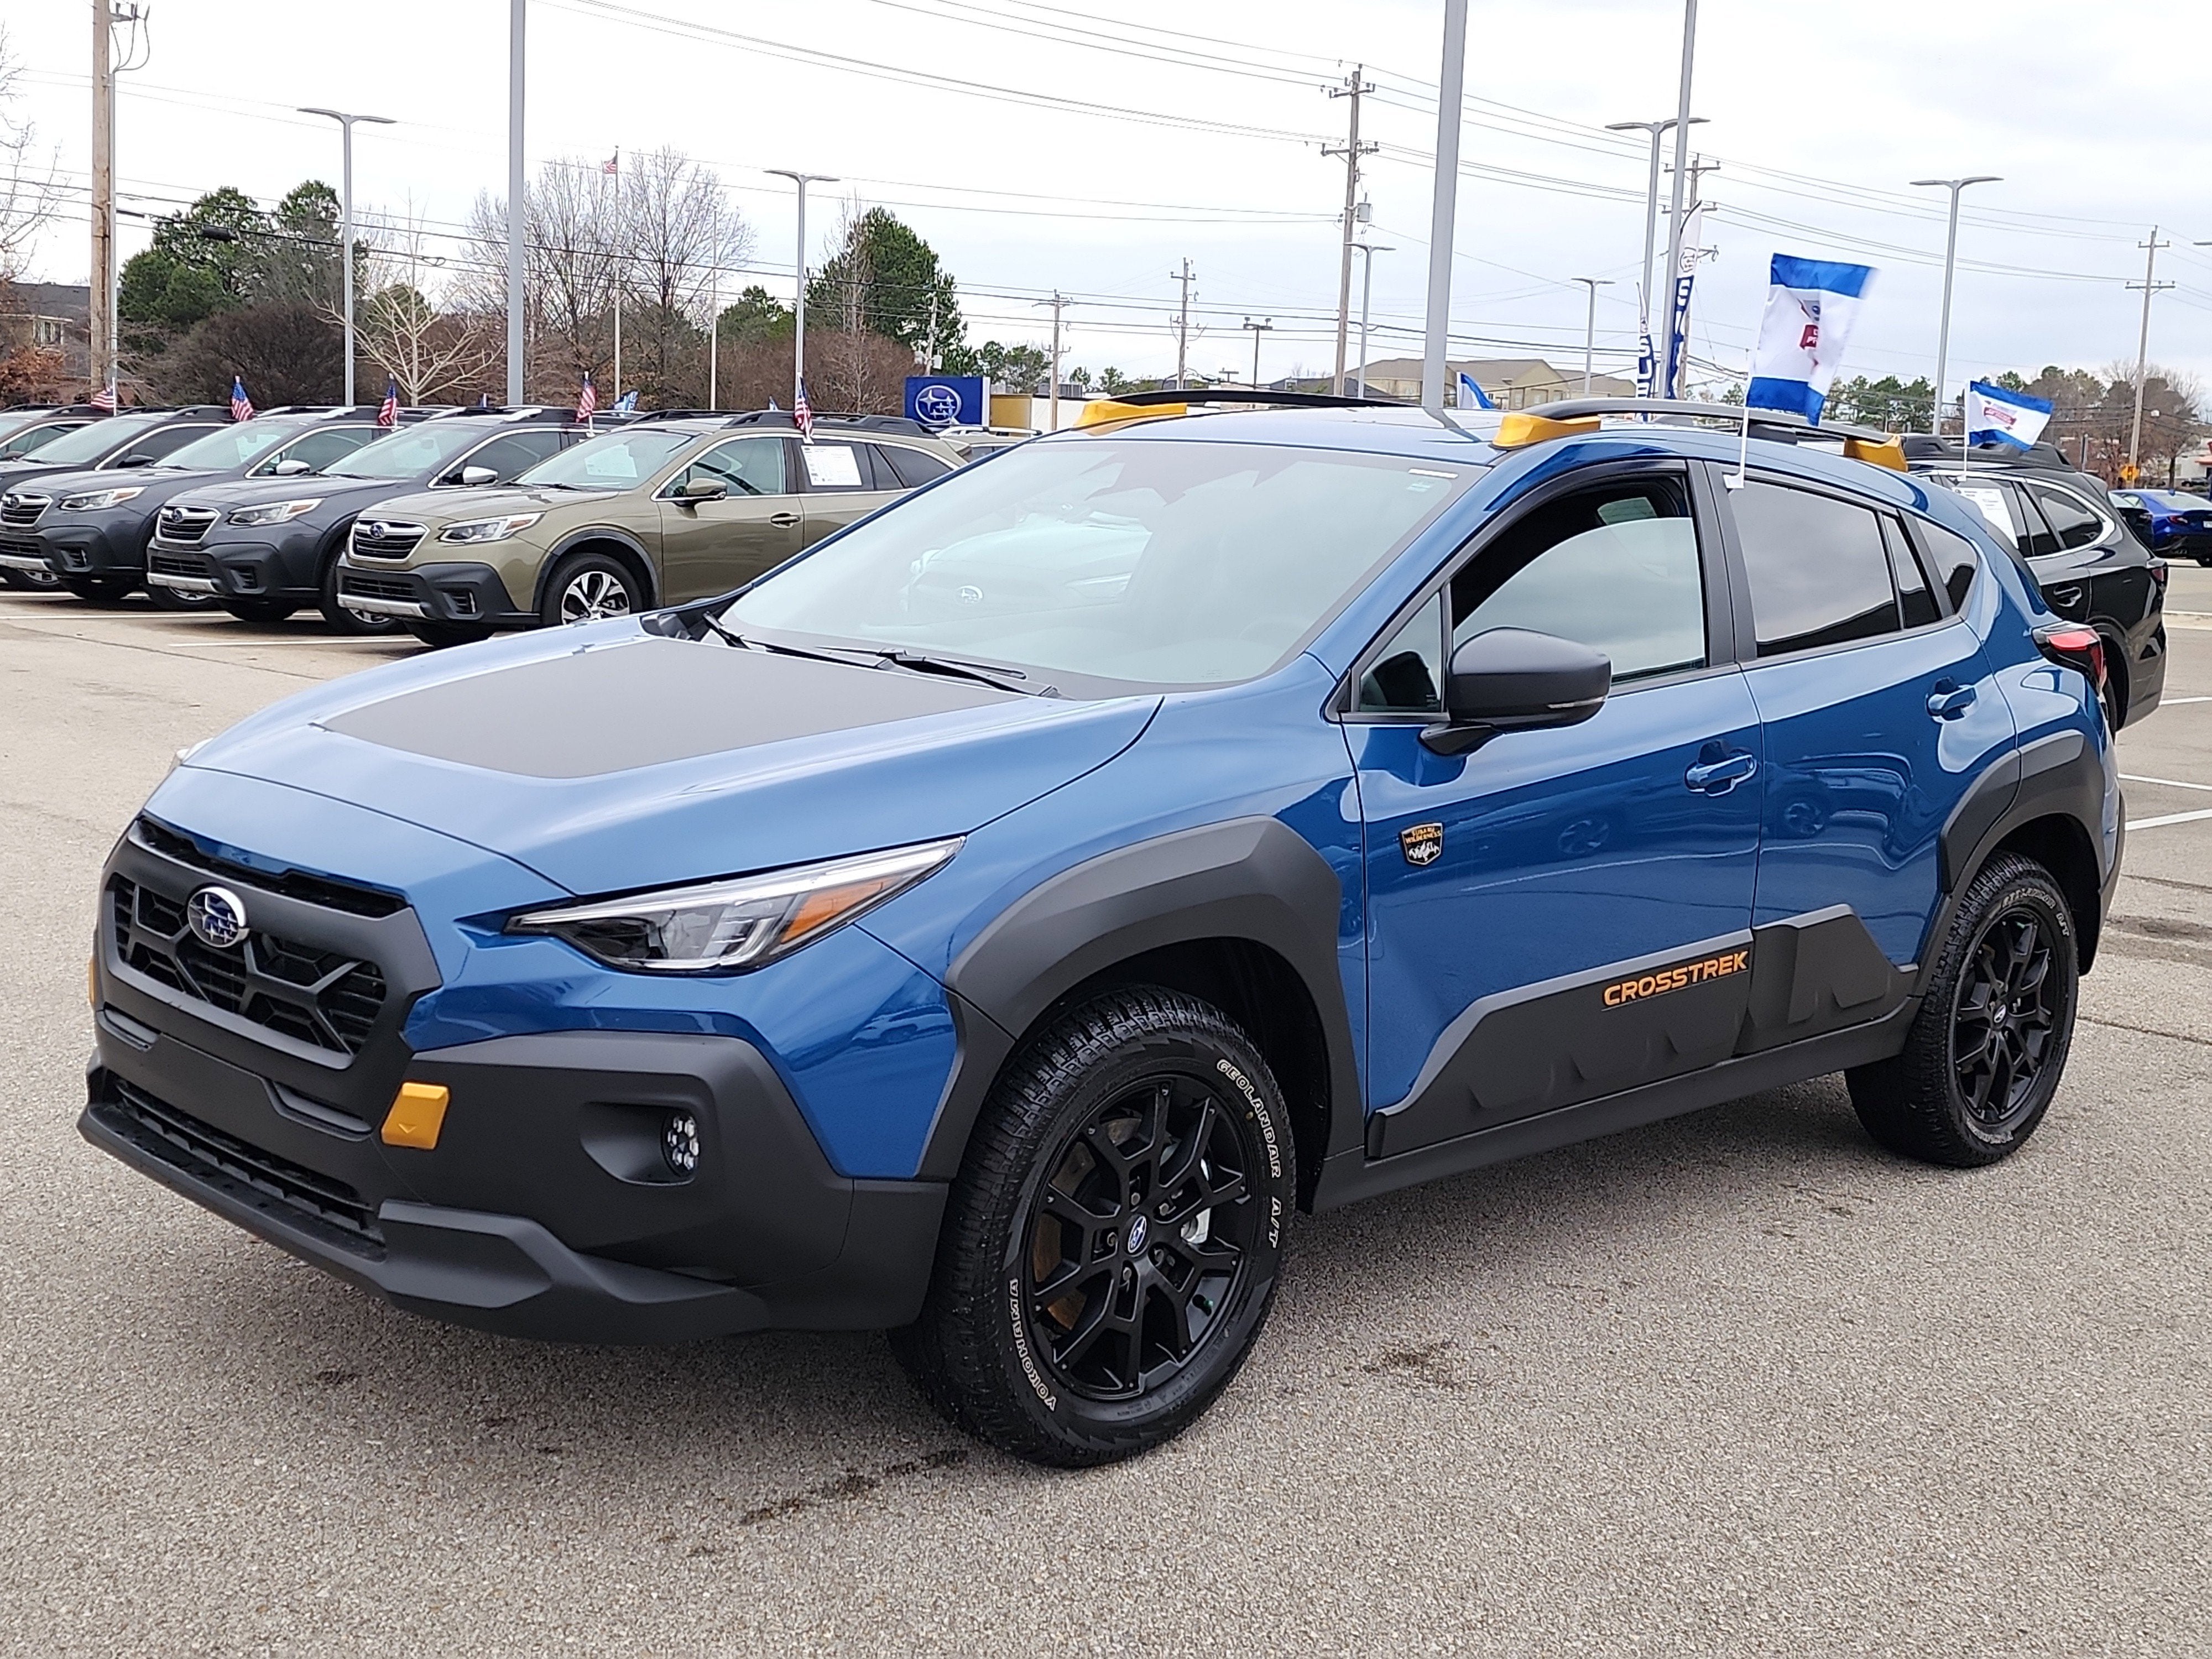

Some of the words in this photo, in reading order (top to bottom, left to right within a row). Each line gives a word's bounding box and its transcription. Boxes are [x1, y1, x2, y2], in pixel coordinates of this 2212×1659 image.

[1604, 951, 1748, 1006] CROSSTREK
[1217, 1059, 1281, 1178] GEOLANDAR
[1269, 1196, 1281, 1249] A/T
[1009, 1278, 1057, 1411] YOKOHAMA
